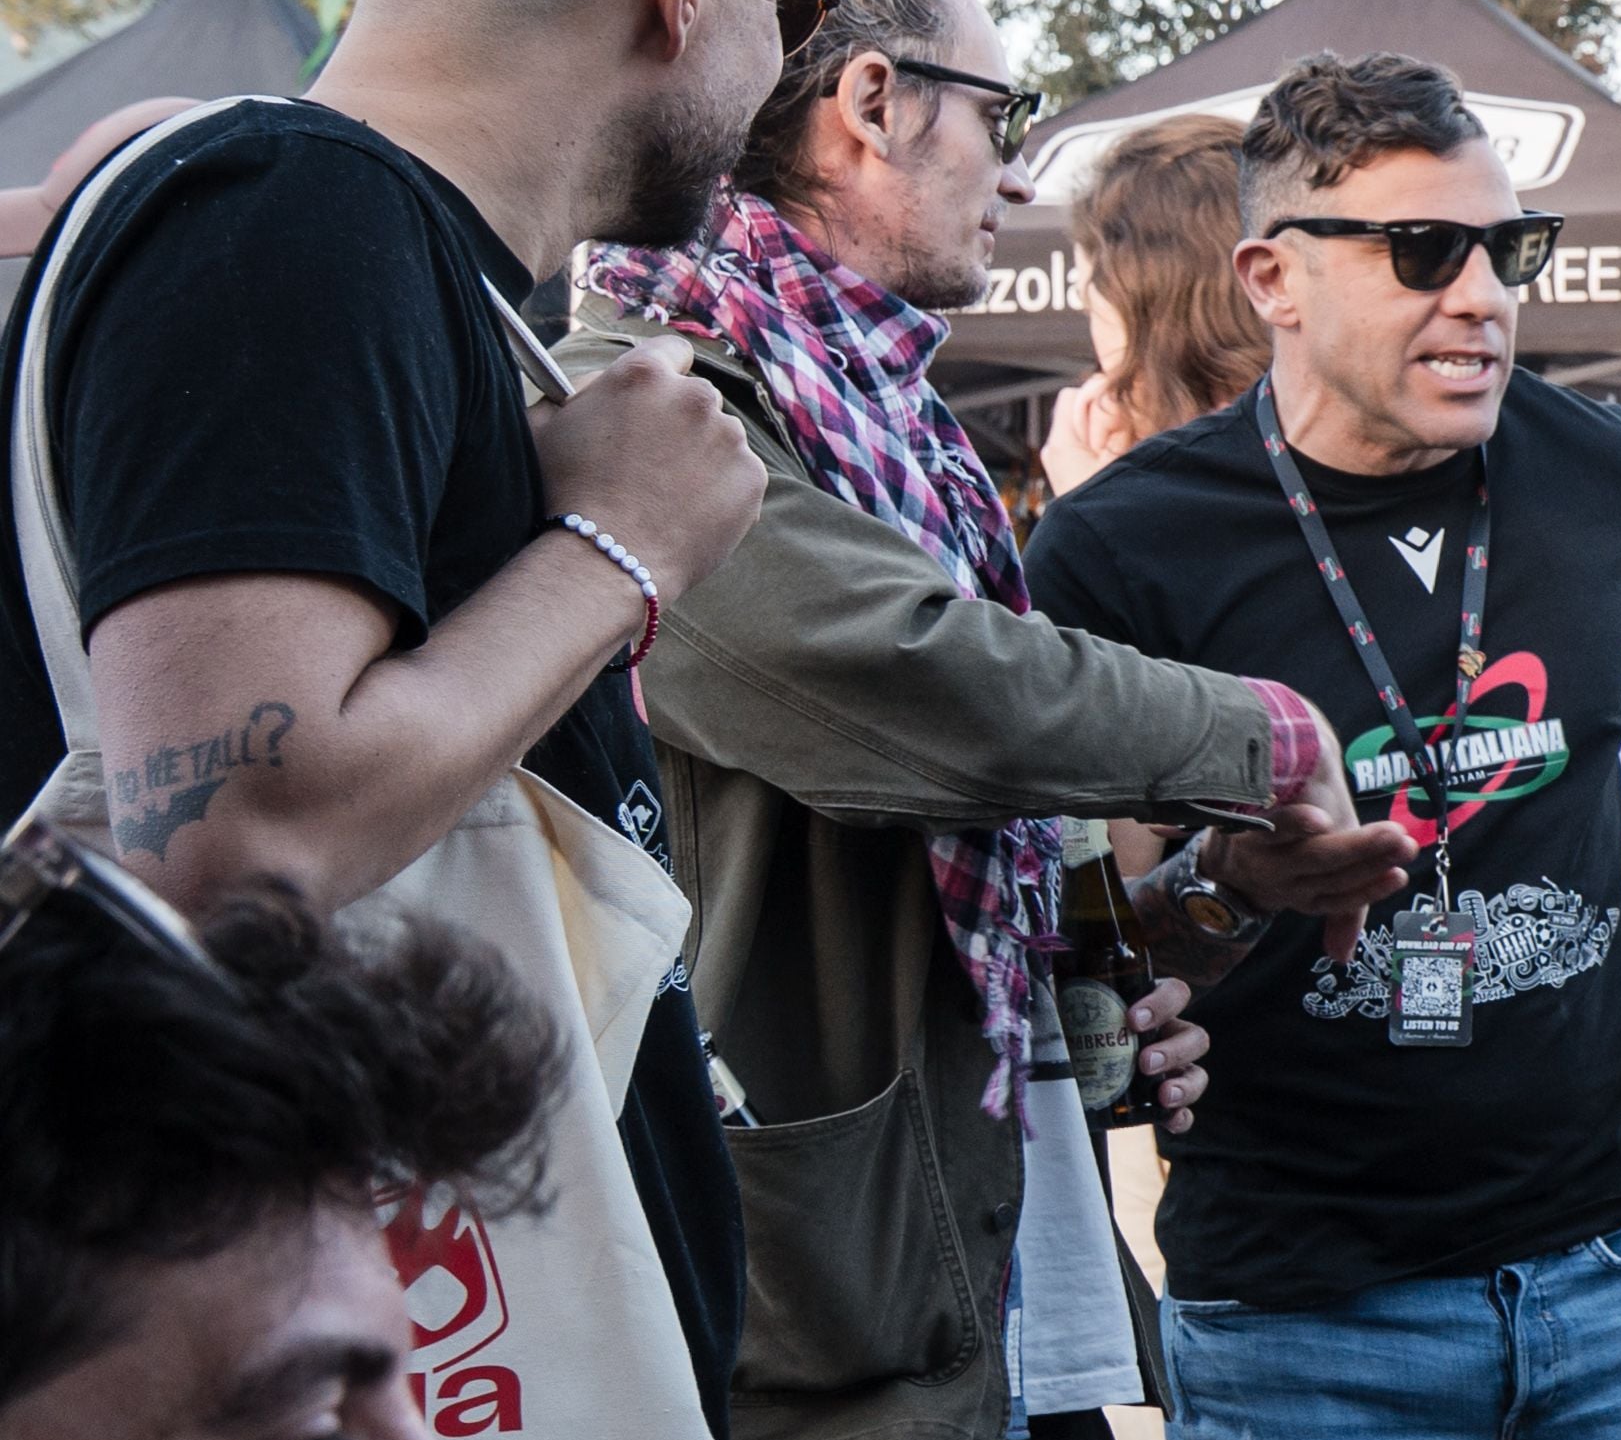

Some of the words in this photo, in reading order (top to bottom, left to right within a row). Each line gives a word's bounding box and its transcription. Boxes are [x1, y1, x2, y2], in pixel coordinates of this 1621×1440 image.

[1396, 940, 1439, 951] DOWNLOAD
[1440, 942, 1455, 951] OUR
[1456, 942, 1471, 952] APP
[1403, 1019, 1434, 1030] LISTEN
[1435, 1020, 1446, 1031] TO
[1448, 1021, 1460, 1031] US
